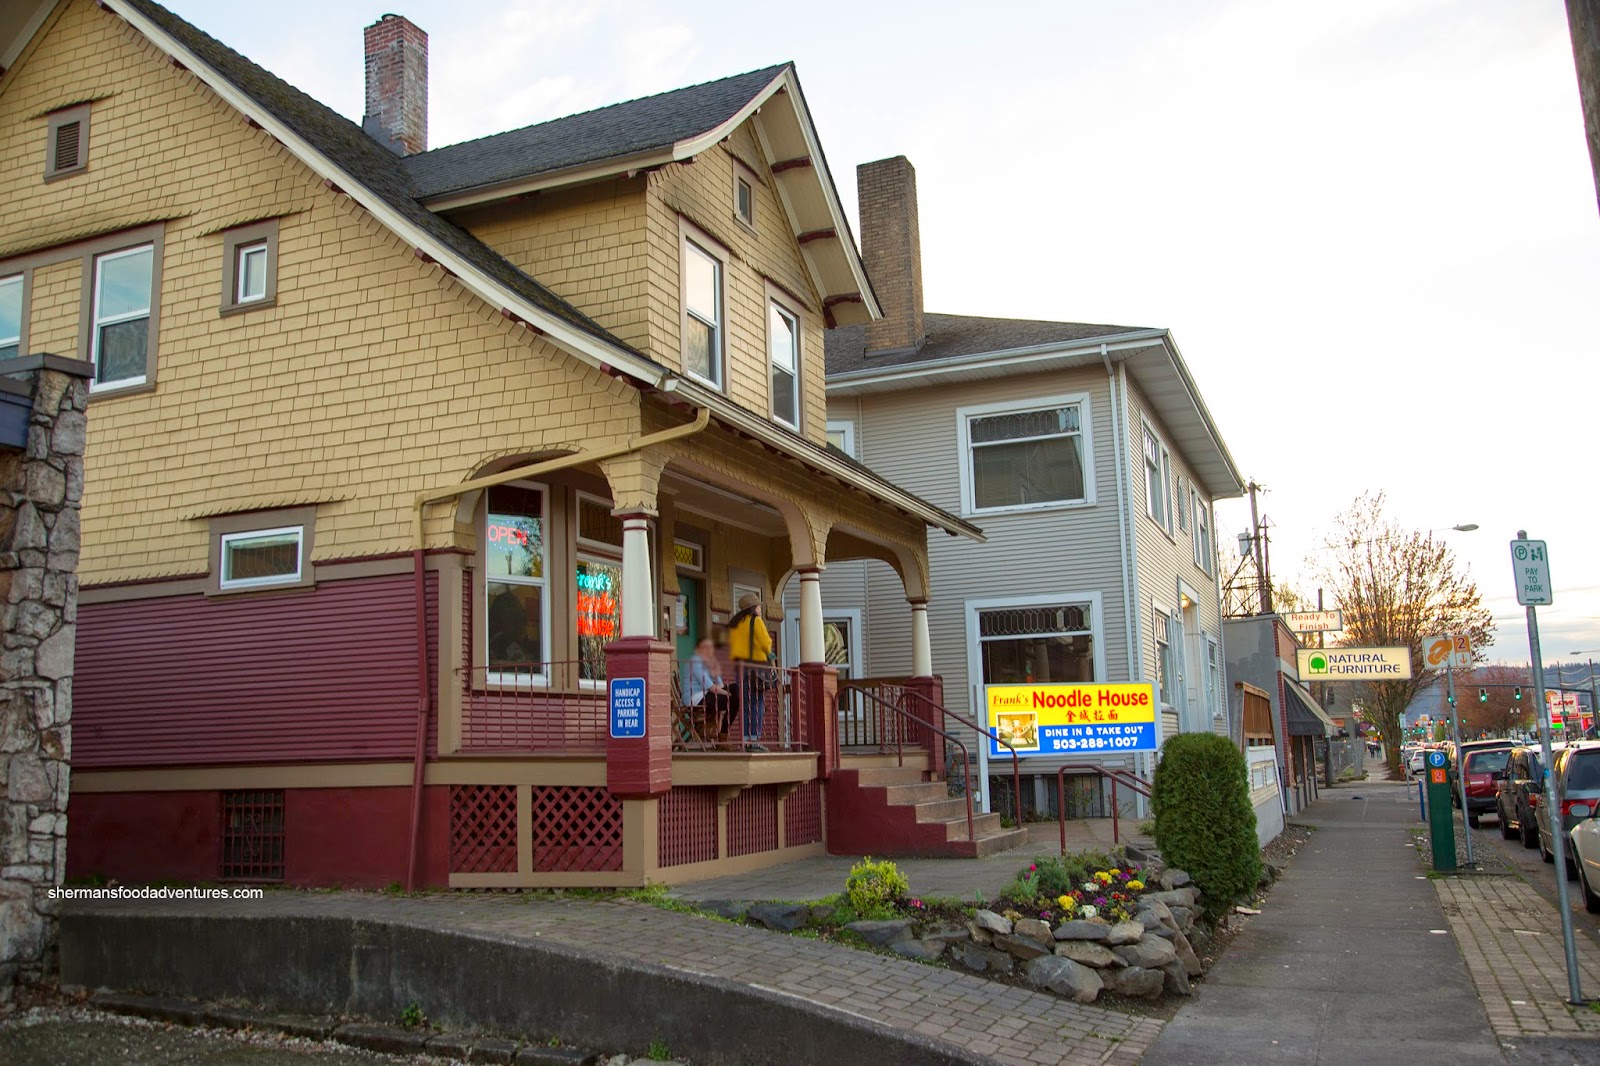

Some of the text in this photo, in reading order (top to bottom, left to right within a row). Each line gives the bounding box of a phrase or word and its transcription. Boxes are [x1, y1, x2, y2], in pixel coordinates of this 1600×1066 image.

[488, 525, 528, 546] OPEN
[576, 571, 611, 591] rank's
[1528, 576, 1538, 584] TO
[1291, 612, 1335, 621] Ready To
[1300, 623, 1329, 631] Finish
[1457, 638, 1465, 649] 2
[1329, 654, 1387, 663] NATURAL
[1329, 664, 1401, 674] FURNITURE
[615, 688, 640, 697] HANDICAP
[615, 698, 641, 708] ACCESS &
[993, 690, 1148, 708] Frank's Noodle House
[617, 708, 639, 718] PARKING
[617, 719, 638, 728] IN REAR
[1045, 726, 1143, 737] DINE IN & TAKE OUT
[1053, 737, 1138, 749] 503-288-1007
